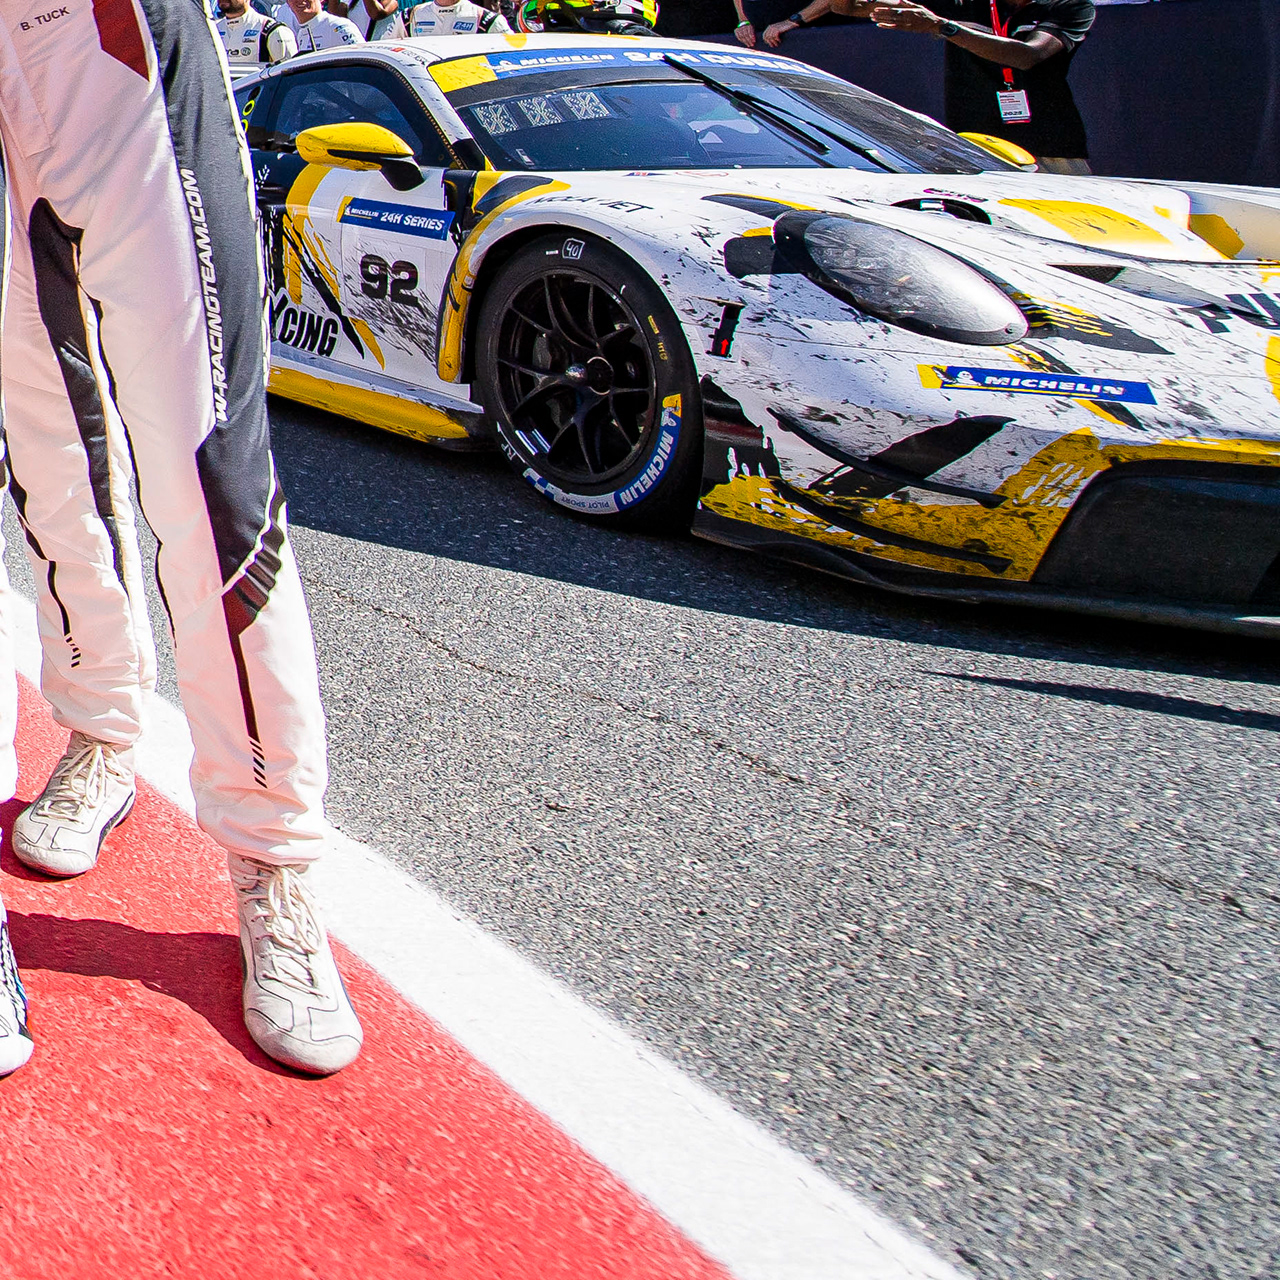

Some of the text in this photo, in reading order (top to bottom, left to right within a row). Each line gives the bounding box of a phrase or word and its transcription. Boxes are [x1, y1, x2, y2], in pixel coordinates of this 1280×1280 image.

[20, 7, 70, 31] B. TUCK
[521, 54, 615, 66] MICHELIN
[350, 208, 445, 230] MICHELIN 24H SERIES
[566, 242, 579, 257] 40
[360, 254, 419, 308] 92
[181, 168, 230, 422] W-RACINGTEAM.COM
[279, 307, 340, 357] CING
[984, 375, 1126, 396] MICHELIN
[619, 431, 674, 505] MICHELIN
[561, 497, 609, 510] PILOT SPORT
